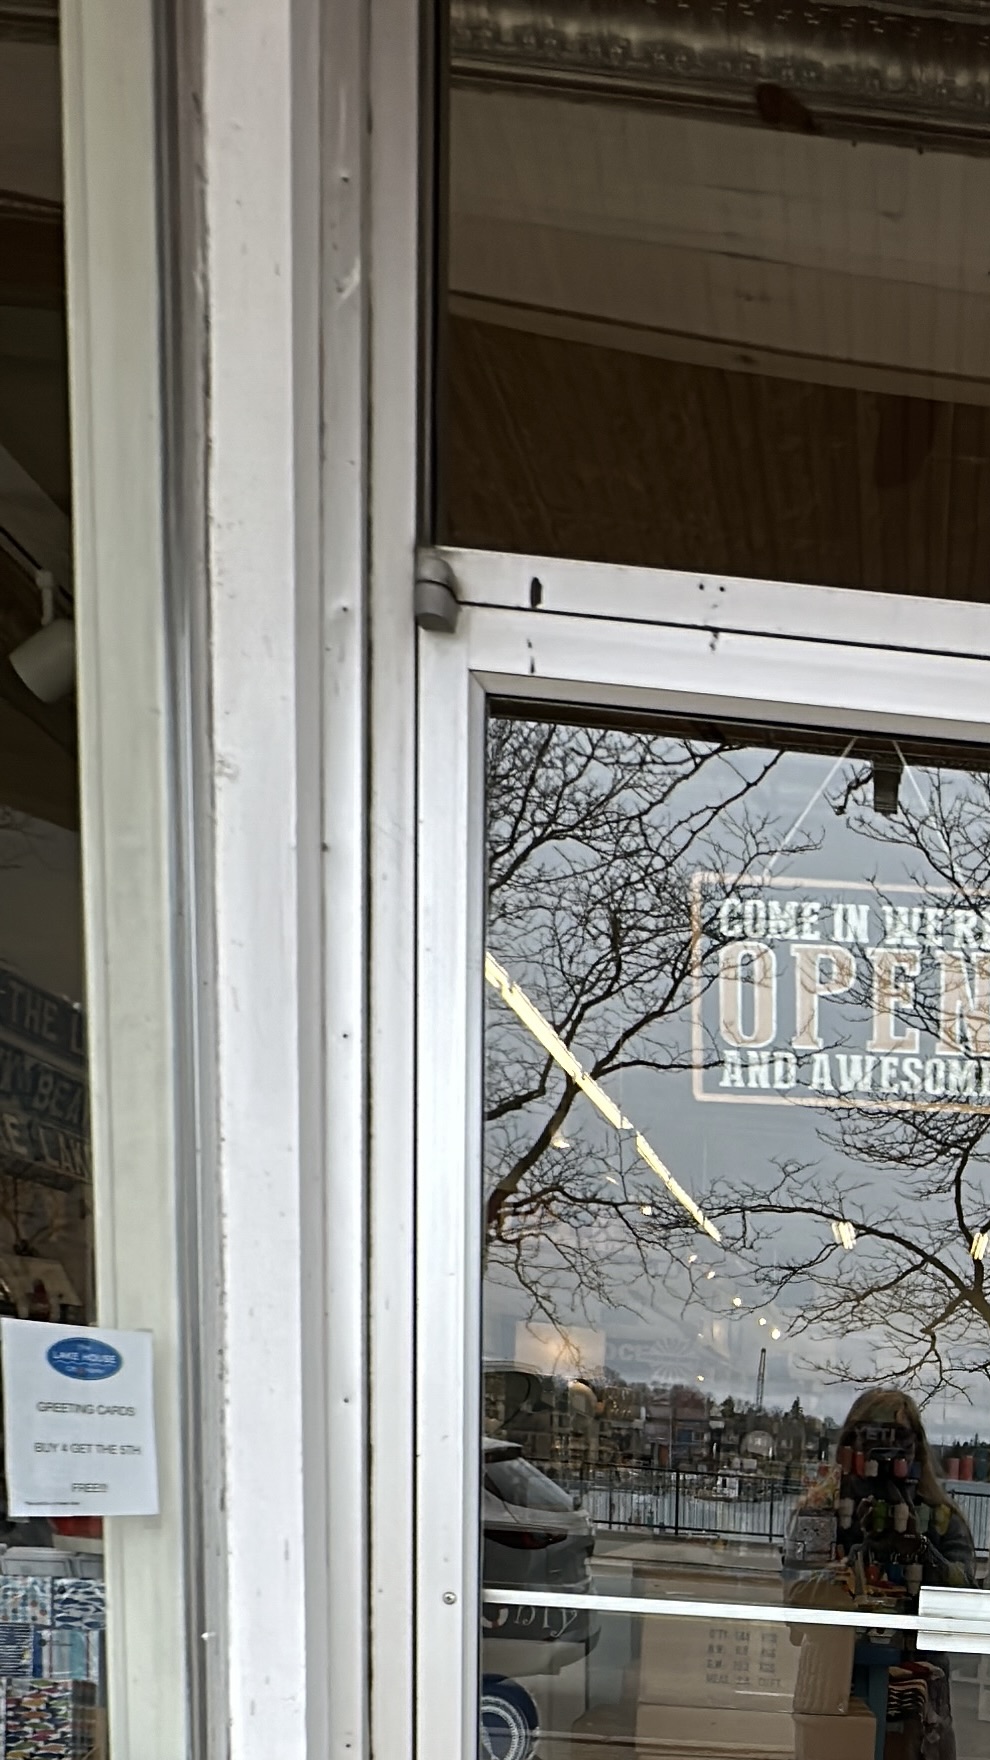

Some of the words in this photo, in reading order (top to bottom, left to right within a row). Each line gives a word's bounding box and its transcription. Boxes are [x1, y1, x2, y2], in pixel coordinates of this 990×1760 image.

[719, 899, 822, 942] COME
[832, 904, 870, 943] IN
[719, 1050, 799, 1090] AND
[52, 1352, 80, 1361] LAKE
[82, 1354, 118, 1364] HOUSE
[36, 1402, 95, 1416] GREETING
[97, 1404, 136, 1417] CARDS
[34, 1442, 58, 1454] BUY
[70, 1443, 93, 1454] GET
[94, 1444, 118, 1455] THE
